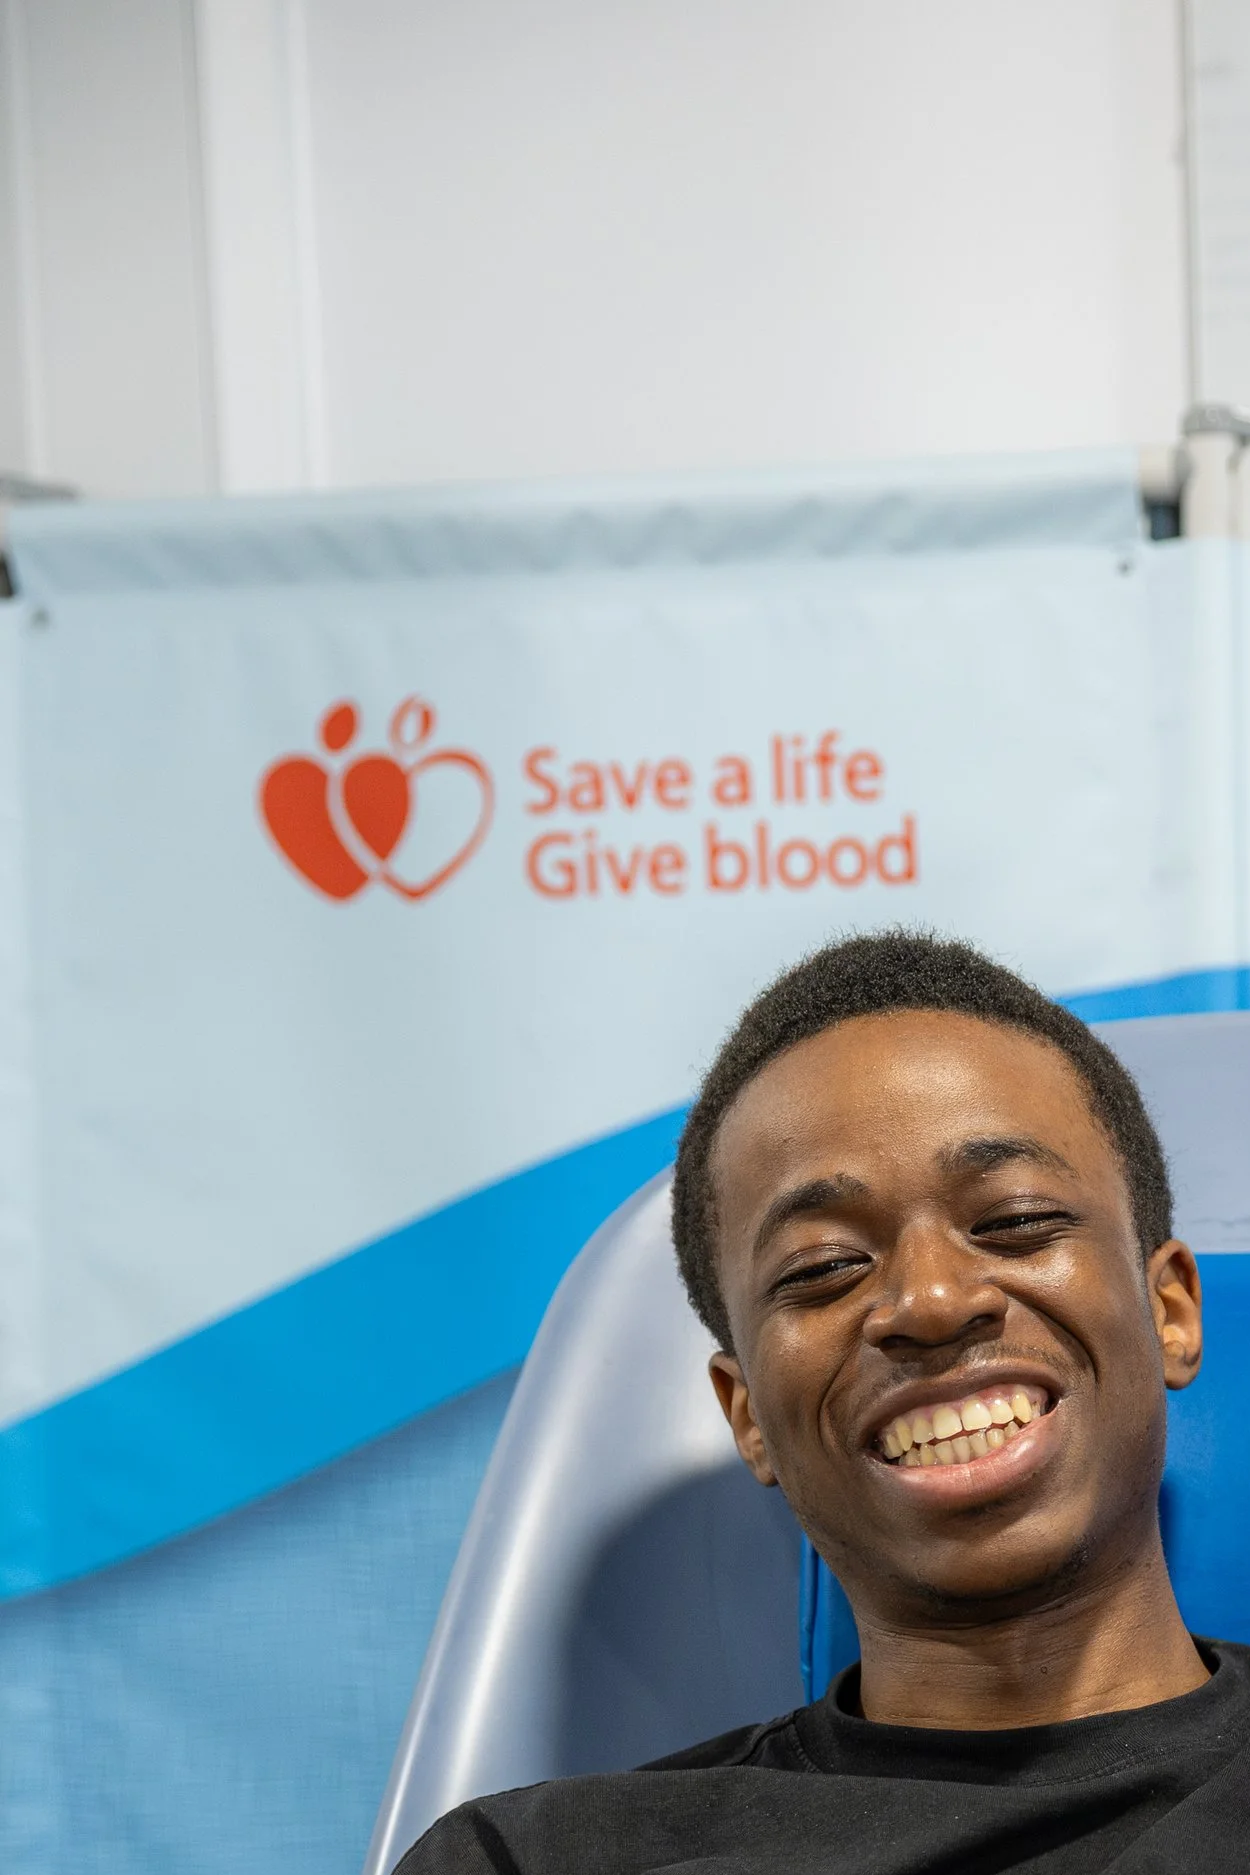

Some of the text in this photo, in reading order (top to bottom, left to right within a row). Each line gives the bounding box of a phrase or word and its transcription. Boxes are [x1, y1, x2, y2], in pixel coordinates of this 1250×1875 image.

[522, 728, 885, 816] Save a life
[522, 810, 918, 900] Give blood
